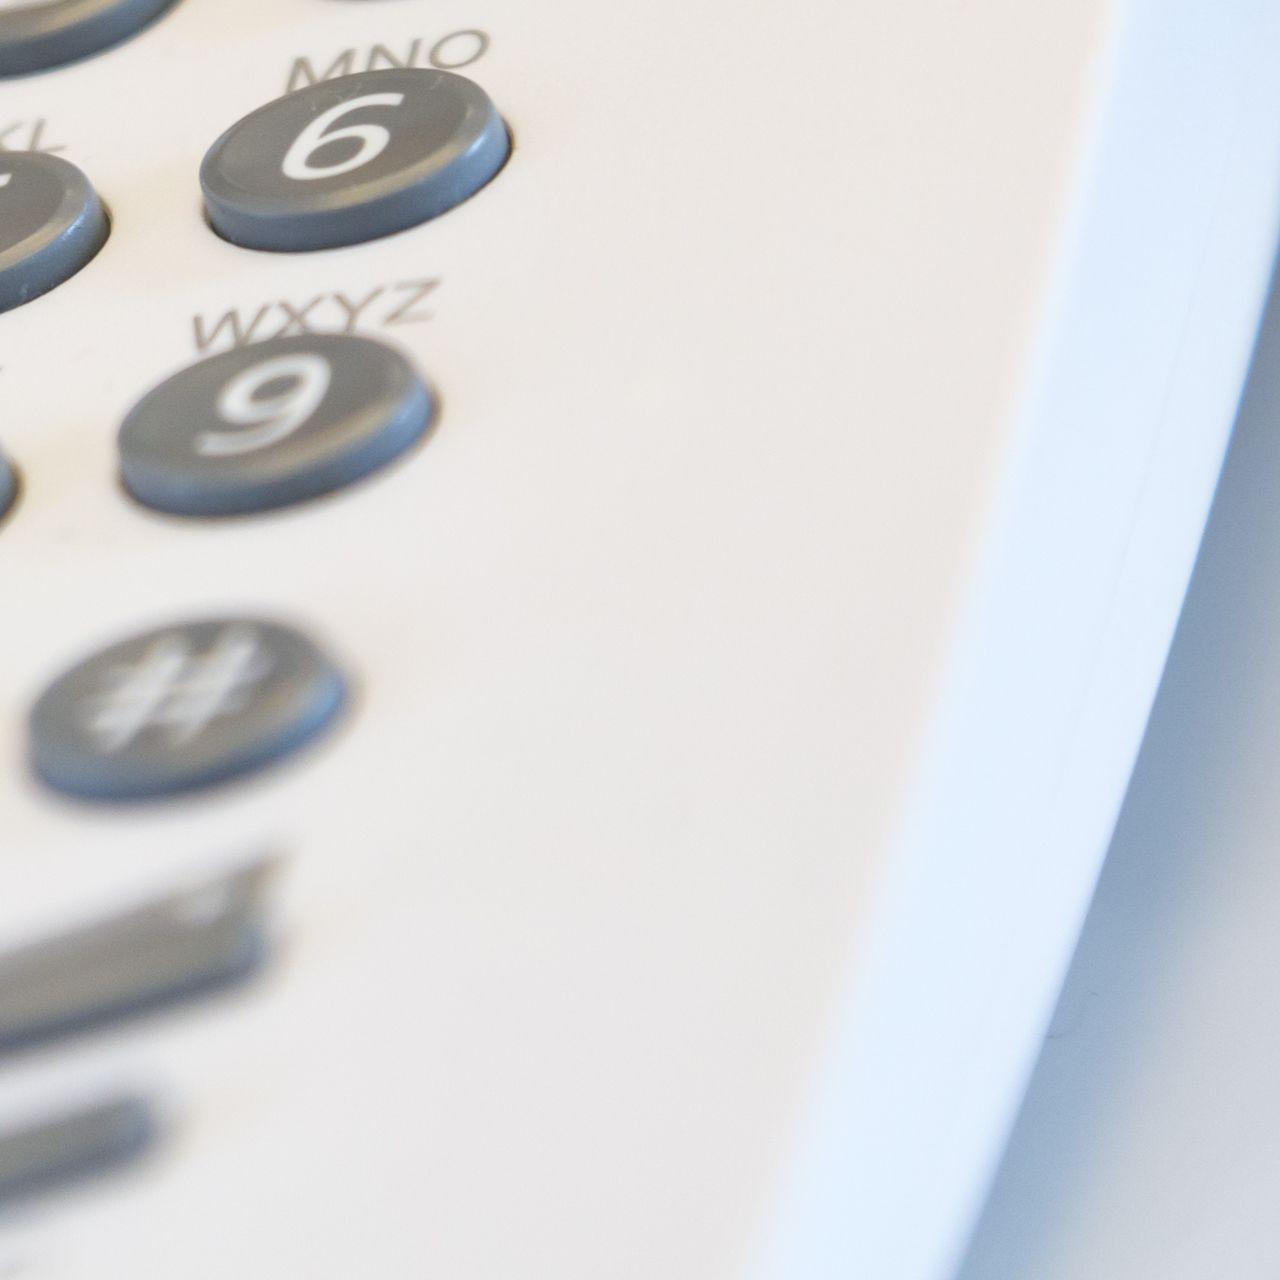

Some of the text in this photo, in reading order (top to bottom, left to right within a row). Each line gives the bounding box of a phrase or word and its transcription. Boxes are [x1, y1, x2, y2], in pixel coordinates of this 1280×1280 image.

[283, 28, 491, 96] MNO
[280, 92, 405, 181] 6
[191, 276, 442, 352] WXYZ
[193, 352, 333, 457] 9
